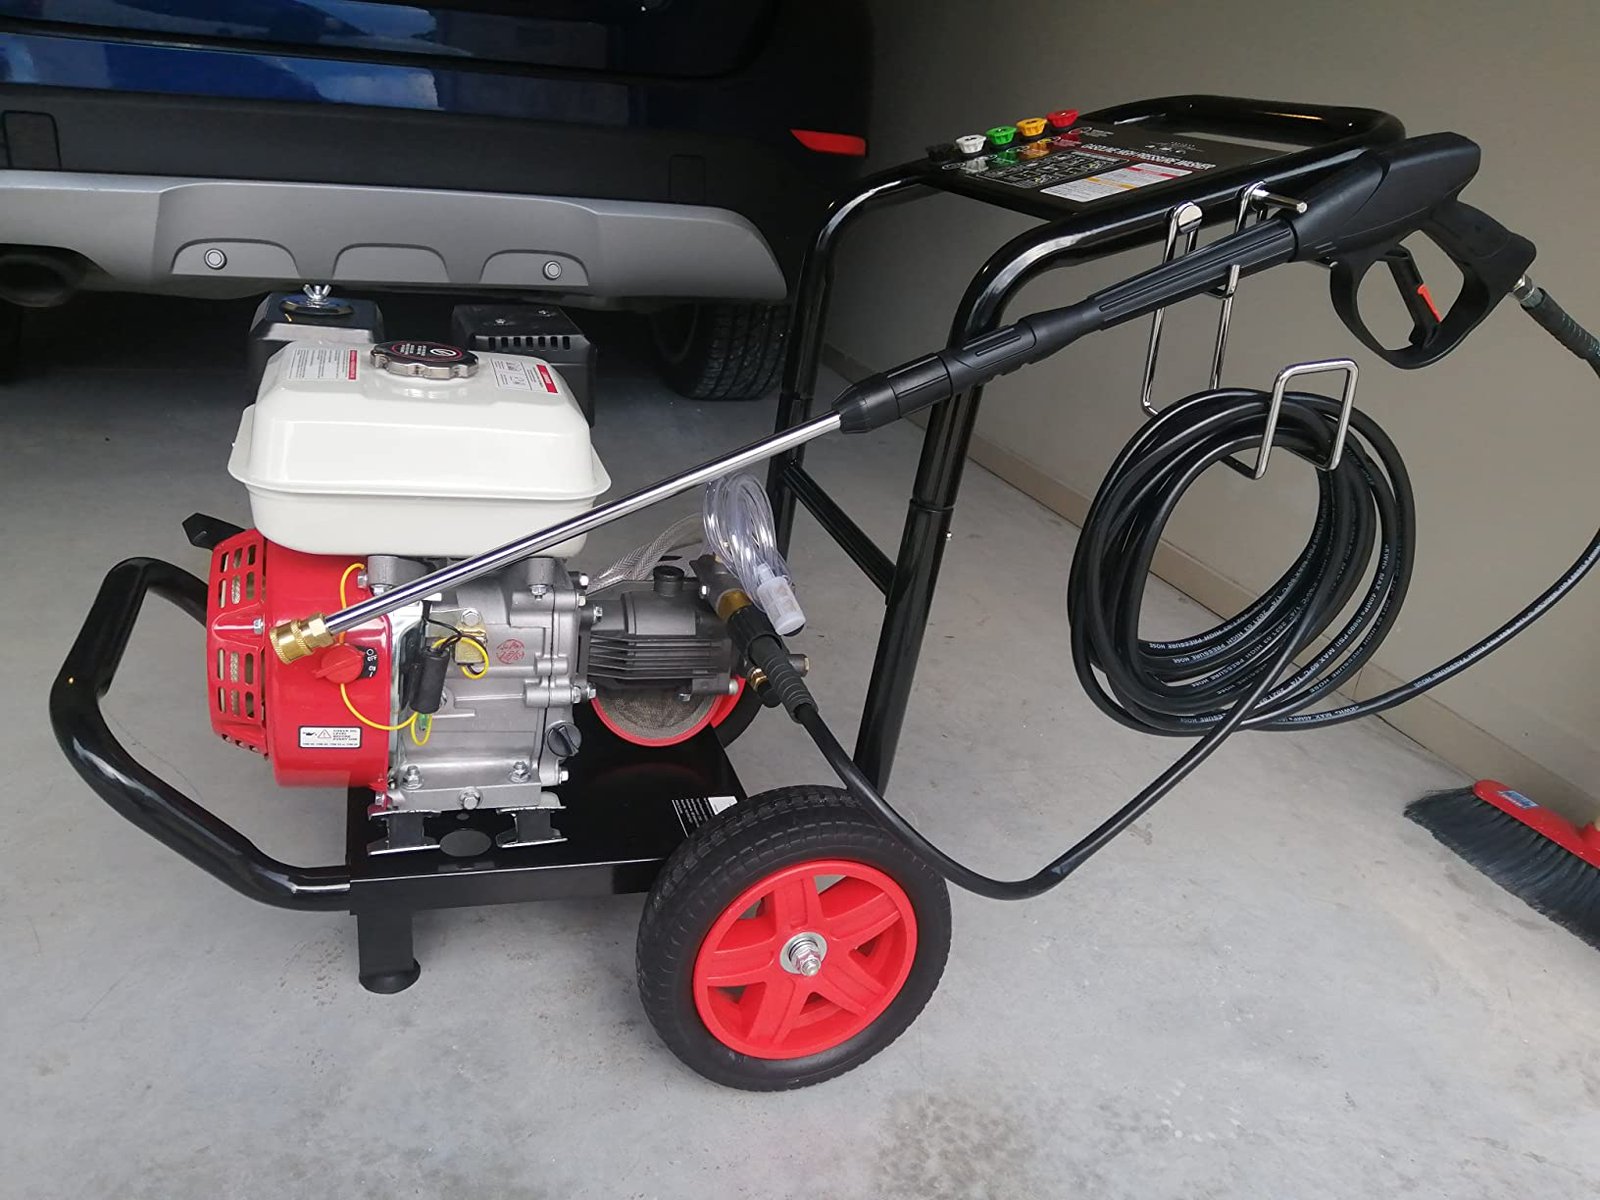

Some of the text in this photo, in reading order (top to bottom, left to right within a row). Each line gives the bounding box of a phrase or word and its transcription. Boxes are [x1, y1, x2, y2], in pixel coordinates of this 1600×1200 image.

[1168, 637, 1203, 650] PRESSURE
[1226, 630, 1244, 645] HIGH
[1190, 643, 1227, 661] PRESSURE
[1245, 644, 1263, 659] HIGH
[1209, 658, 1246, 681] PRESSURE
[1309, 677, 1330, 694] HOSE
